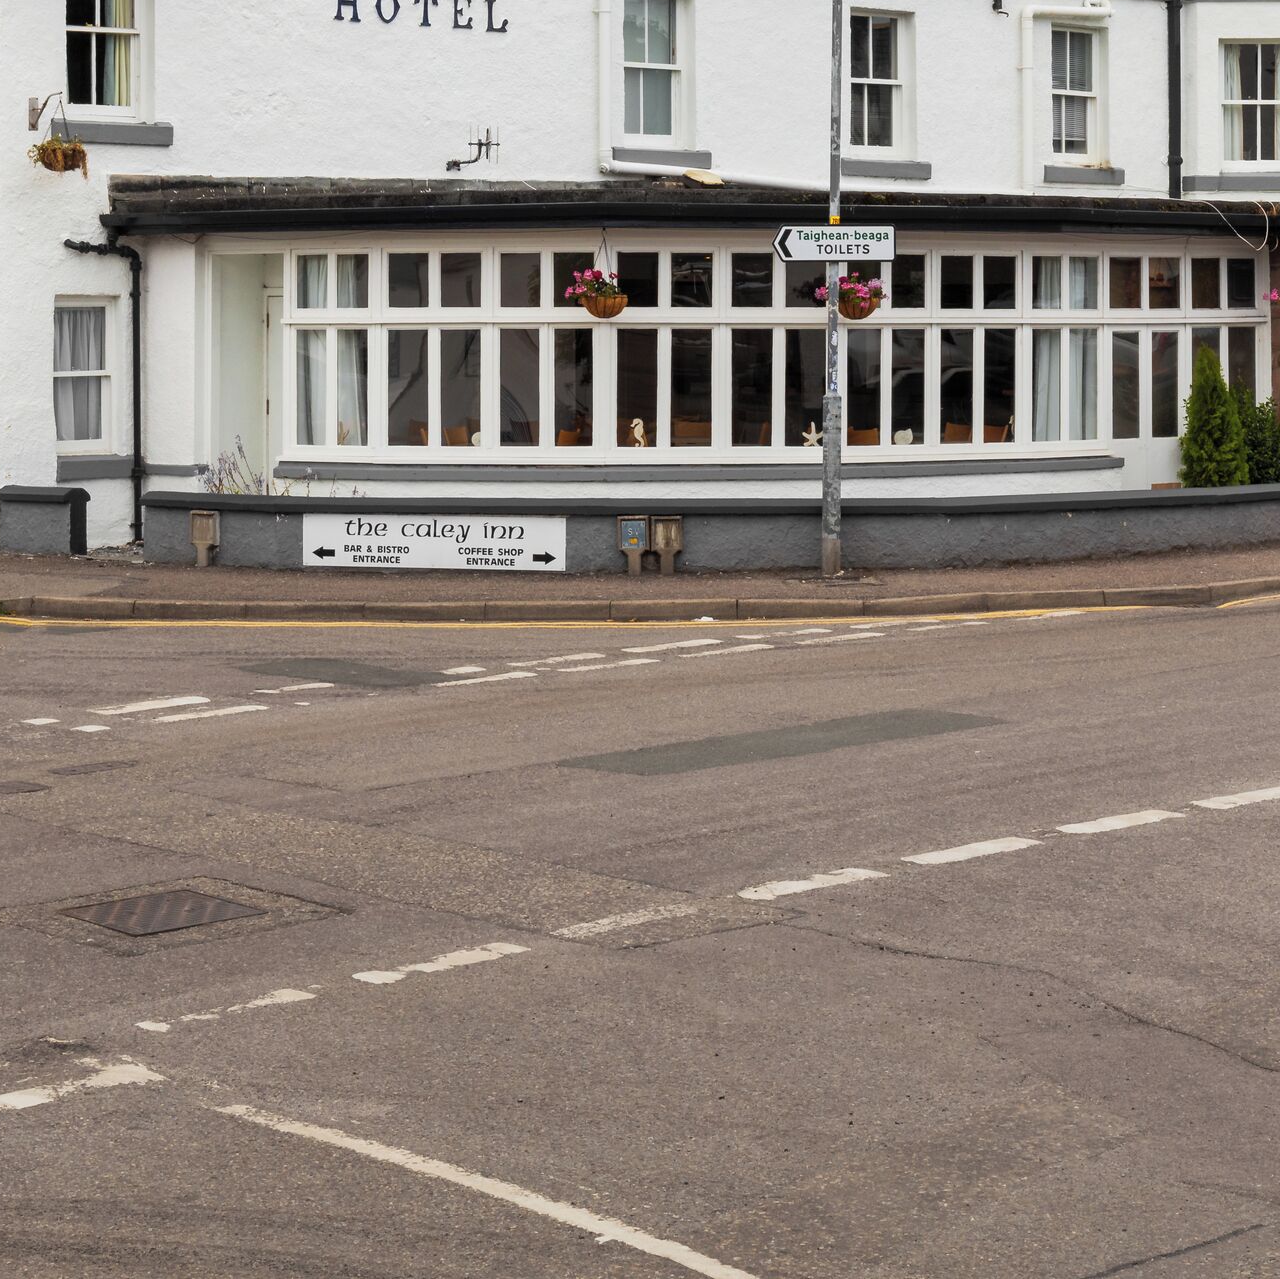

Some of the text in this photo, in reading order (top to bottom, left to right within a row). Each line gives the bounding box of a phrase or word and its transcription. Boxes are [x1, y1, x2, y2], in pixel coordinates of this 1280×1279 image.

[796, 230, 889, 243] Taighean-beaga
[816, 244, 870, 255] TOILETS
[345, 517, 525, 544] the caley inn
[344, 545, 410, 554] BAR & BISTRO
[458, 547, 524, 556] COFFEE SHOP
[353, 555, 401, 564] ENTRANCE
[466, 557, 516, 566] ENTRANCE
